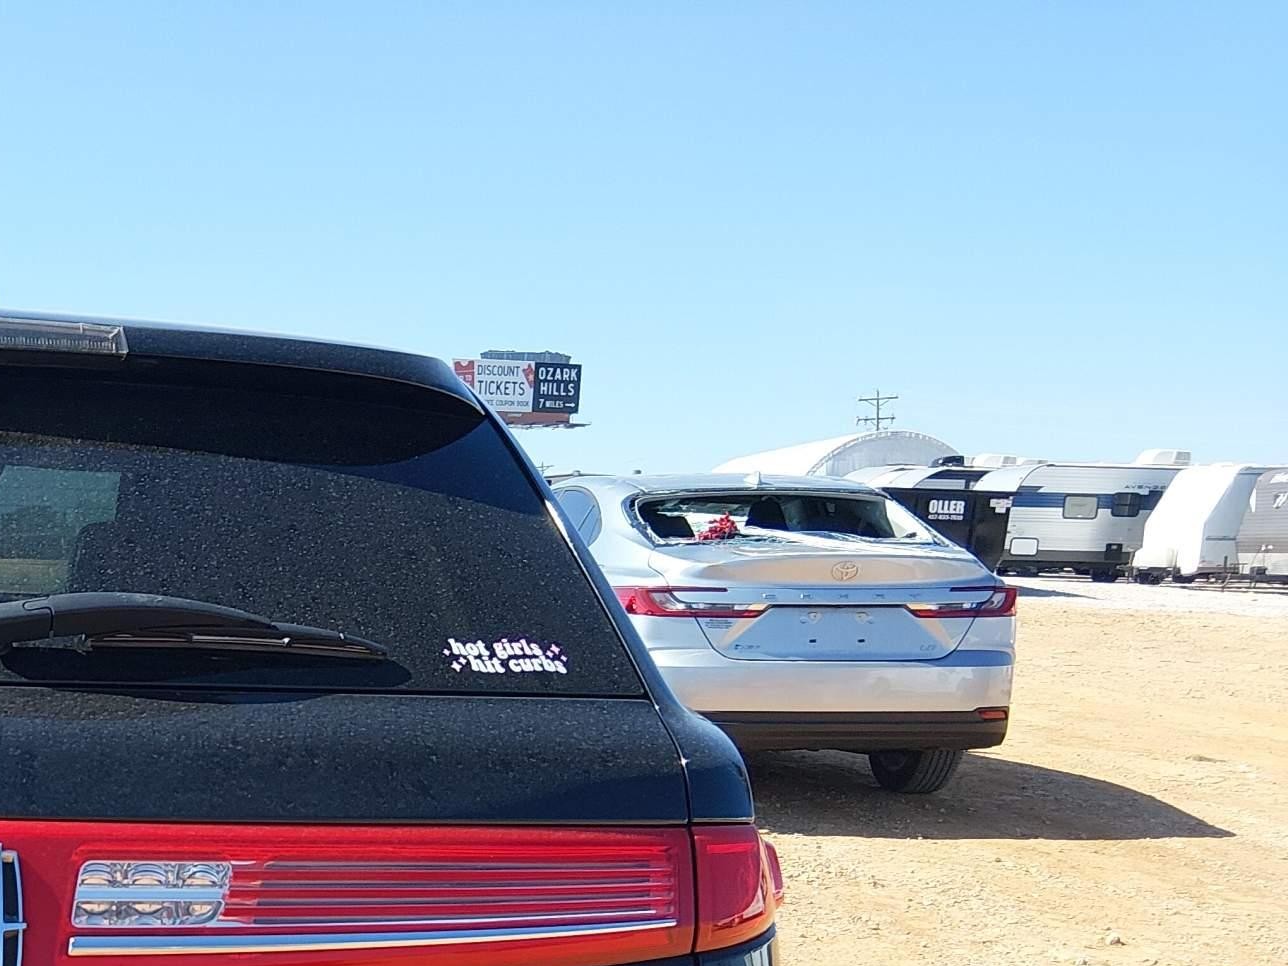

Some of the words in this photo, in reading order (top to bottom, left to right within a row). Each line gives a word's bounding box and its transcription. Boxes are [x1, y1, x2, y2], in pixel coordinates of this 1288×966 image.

[477, 364, 520, 377] DISCOUNT
[538, 367, 578, 381] OZARK
[477, 380, 525, 396] TICKETS
[540, 383, 575, 396] HILLS
[538, 399, 544, 408] 7
[545, 400, 563, 408] MILES
[928, 499, 965, 514] OLLER
[447, 638, 490, 656] hot
[492, 639, 543, 659] girls
[467, 655, 505, 673] hit
[508, 656, 567, 674] curbs
